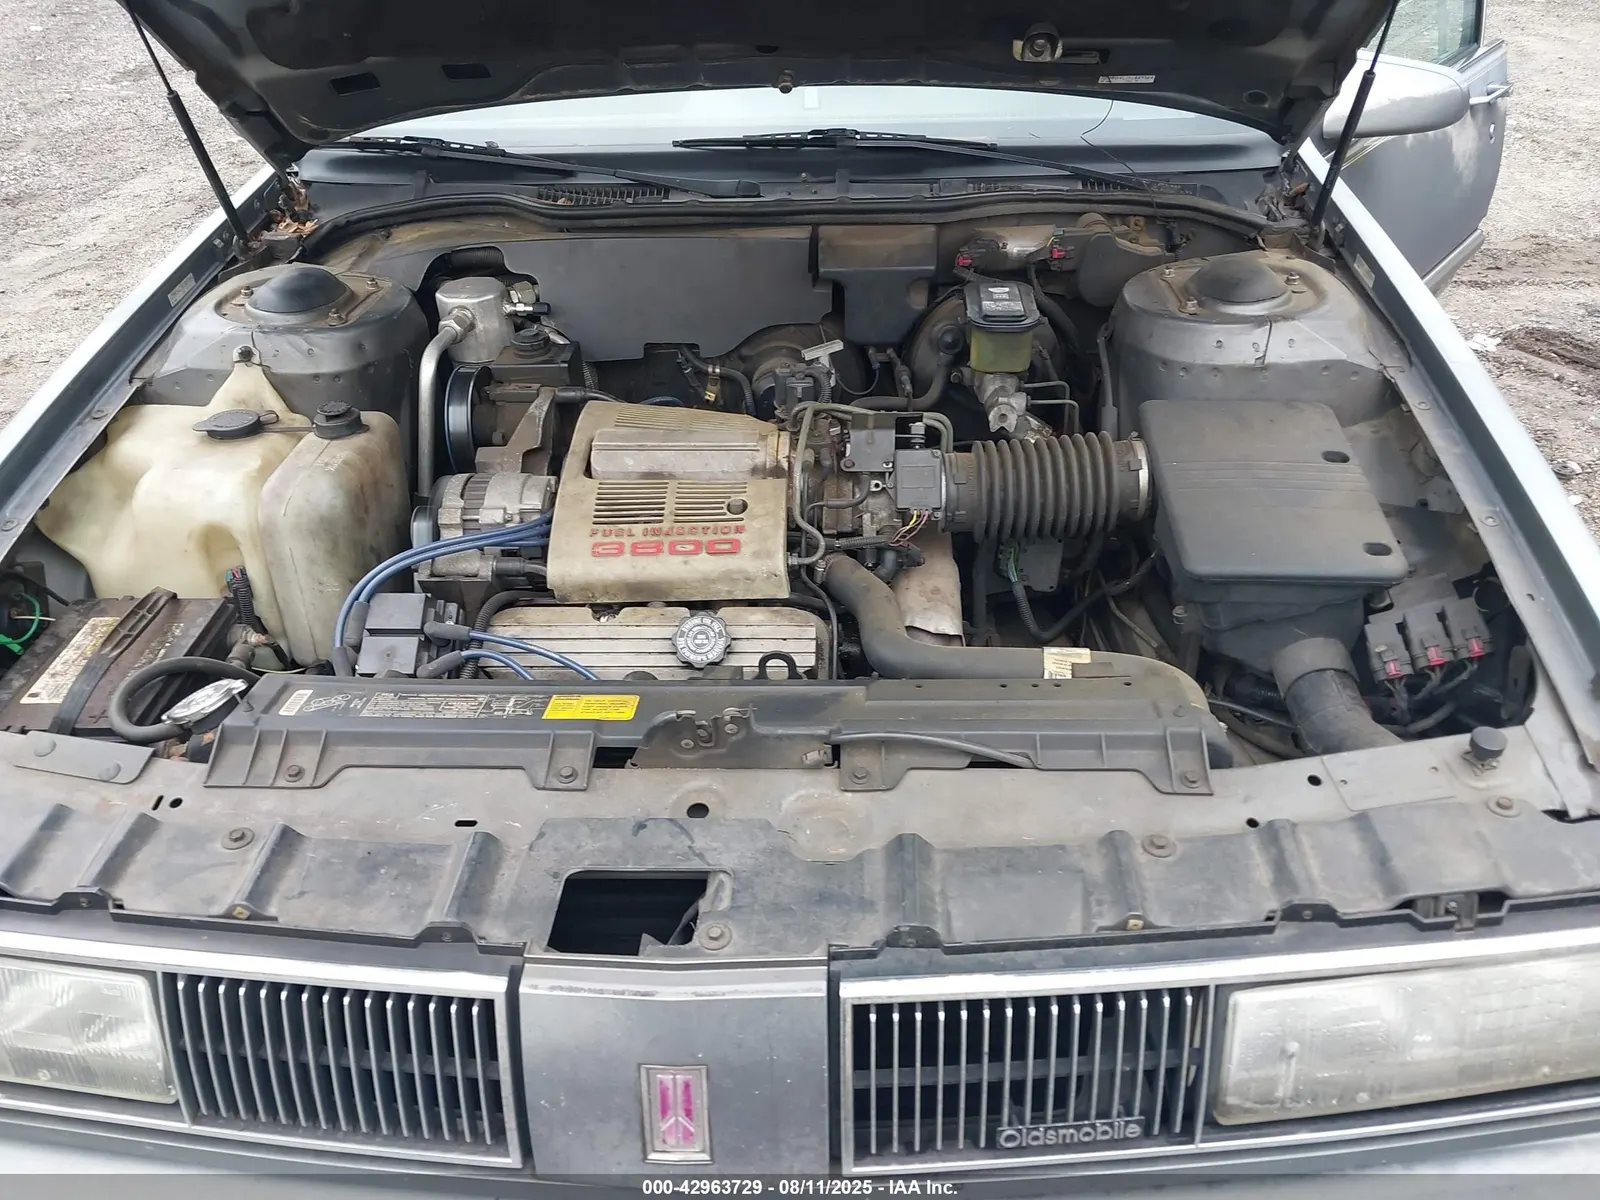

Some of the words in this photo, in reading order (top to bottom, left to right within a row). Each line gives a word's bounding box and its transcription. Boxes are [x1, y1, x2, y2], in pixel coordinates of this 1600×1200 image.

[590, 527, 635, 538] FUEL
[642, 525, 745, 537] INJECTION
[592, 539, 741, 557] 3800
[999, 1121, 1142, 1149] Oldsmobile
